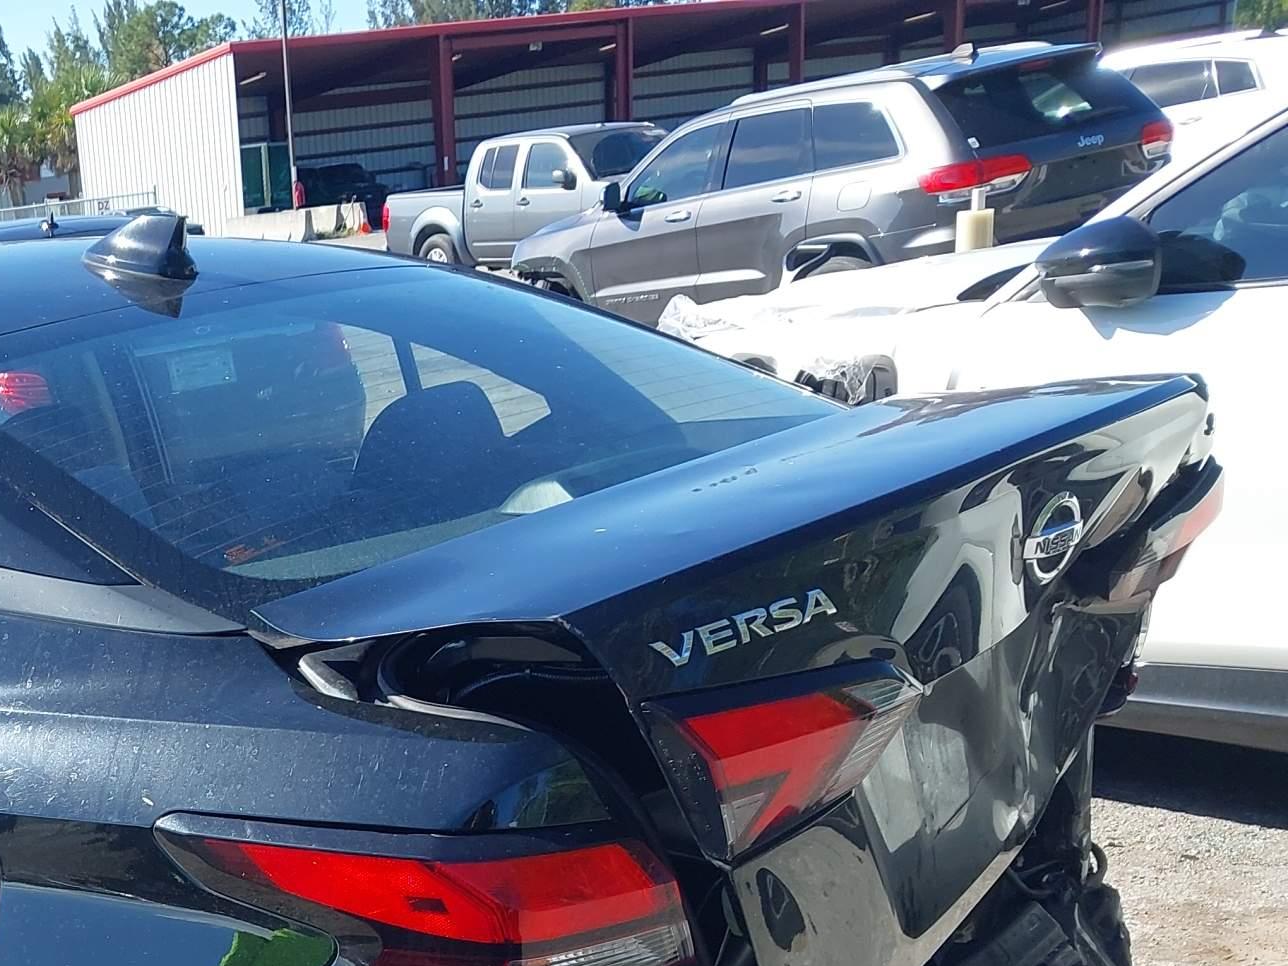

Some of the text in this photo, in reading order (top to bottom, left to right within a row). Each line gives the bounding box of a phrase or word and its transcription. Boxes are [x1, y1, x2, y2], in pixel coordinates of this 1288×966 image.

[1077, 134, 1105, 147] Jeep
[97, 200, 110, 210] DZ
[1033, 525, 1083, 555] NISSAN
[649, 588, 838, 667] VERSA
